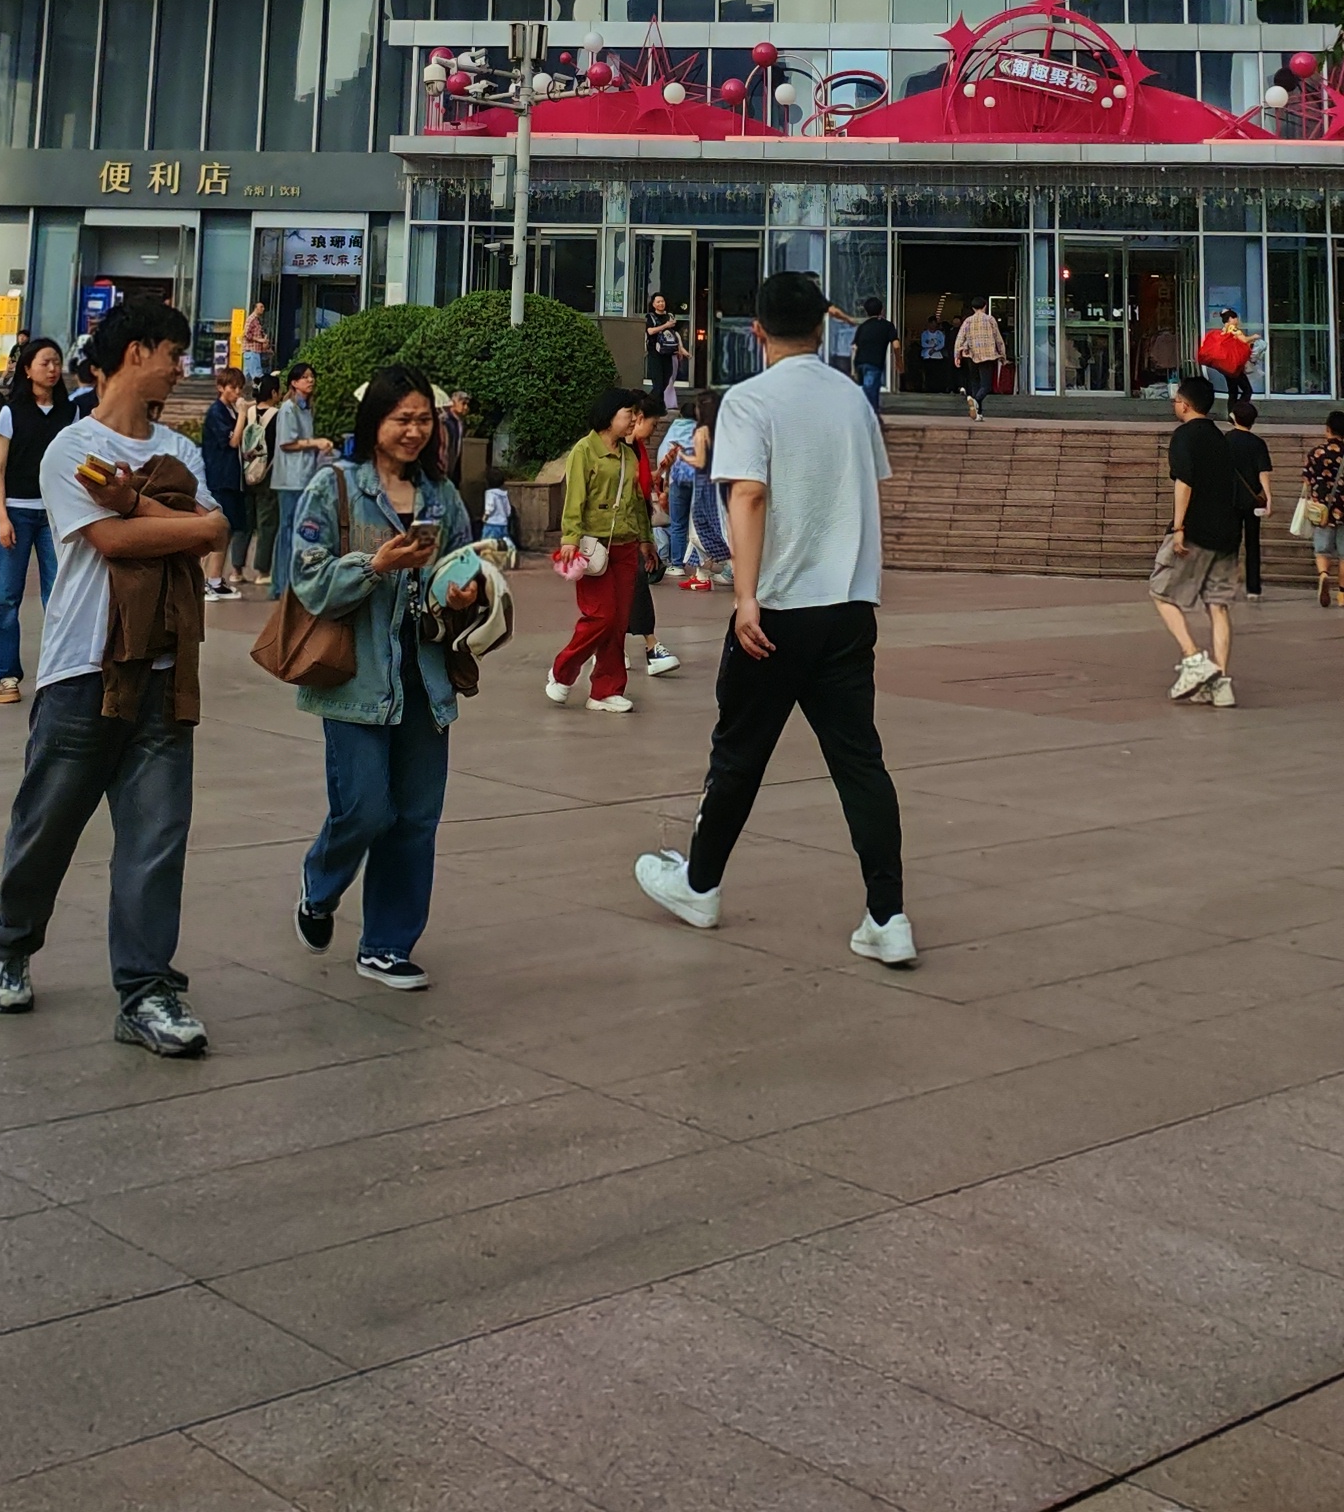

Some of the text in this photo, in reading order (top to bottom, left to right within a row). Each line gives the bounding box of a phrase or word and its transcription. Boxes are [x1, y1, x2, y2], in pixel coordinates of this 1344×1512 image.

[99, 160, 232, 195] 便利店
[311, 235, 363, 249] 琅琊阁
[292, 253, 319, 267] 品茶
